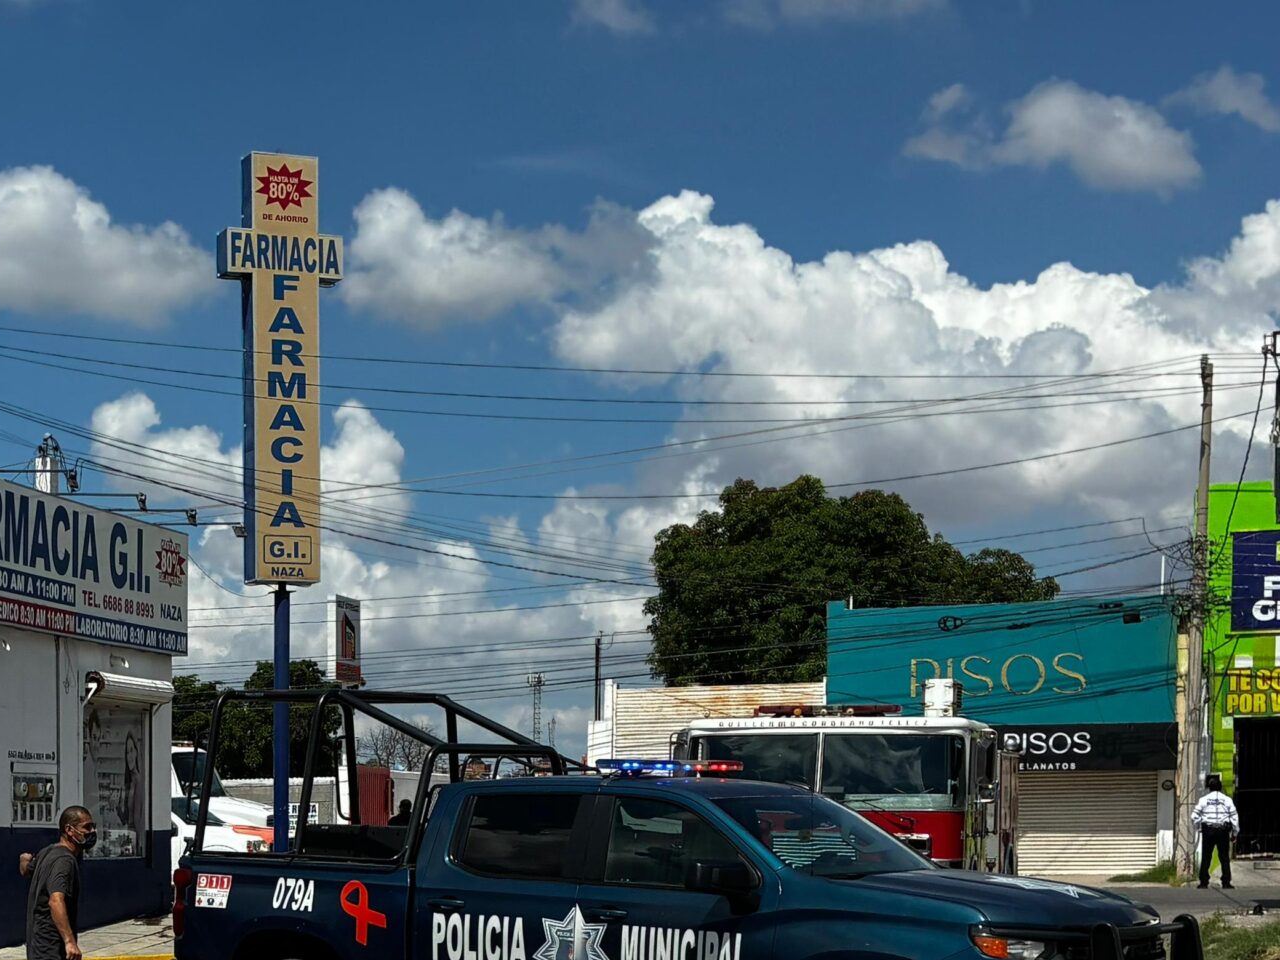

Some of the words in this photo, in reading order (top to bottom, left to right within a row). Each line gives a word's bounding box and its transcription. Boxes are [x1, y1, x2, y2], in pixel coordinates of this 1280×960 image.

[269, 182, 300, 201] 80%
[262, 213, 273, 221] DE
[275, 214, 309, 224] AHORRO
[230, 231, 340, 275] FARMACIA
[268, 274, 306, 528] FARMACIA
[109, 522, 151, 594] G.I.
[269, 541, 306, 559] G.I.
[271, 566, 305, 578] NAZA
[10, 576, 25, 592] AM
[26, 578, 34, 594] A
[36, 579, 60, 599] 11:00
[61, 583, 75, 604] PM
[82, 589, 101, 609] TEL.
[102, 594, 123, 613] 6686
[124, 599, 134, 615] 88
[135, 601, 155, 619] 8993
[160, 603, 183, 623] NAZA
[1252, 599, 1280, 621] G
[20, 605, 35, 626] 8:30
[35, 609, 47, 627] AM
[65, 614, 75, 633] PM
[75, 616, 128, 643] LABORATORIO
[129, 626, 145, 646] 8:30
[145, 630, 157, 647] AM
[176, 635, 187, 653] AM
[1227, 669, 1251, 691] TE
[1226, 692, 1266, 714] POR
[1003, 731, 1092, 755] PISOS
[199, 875, 229, 889] 911
[272, 877, 315, 912] 079A
